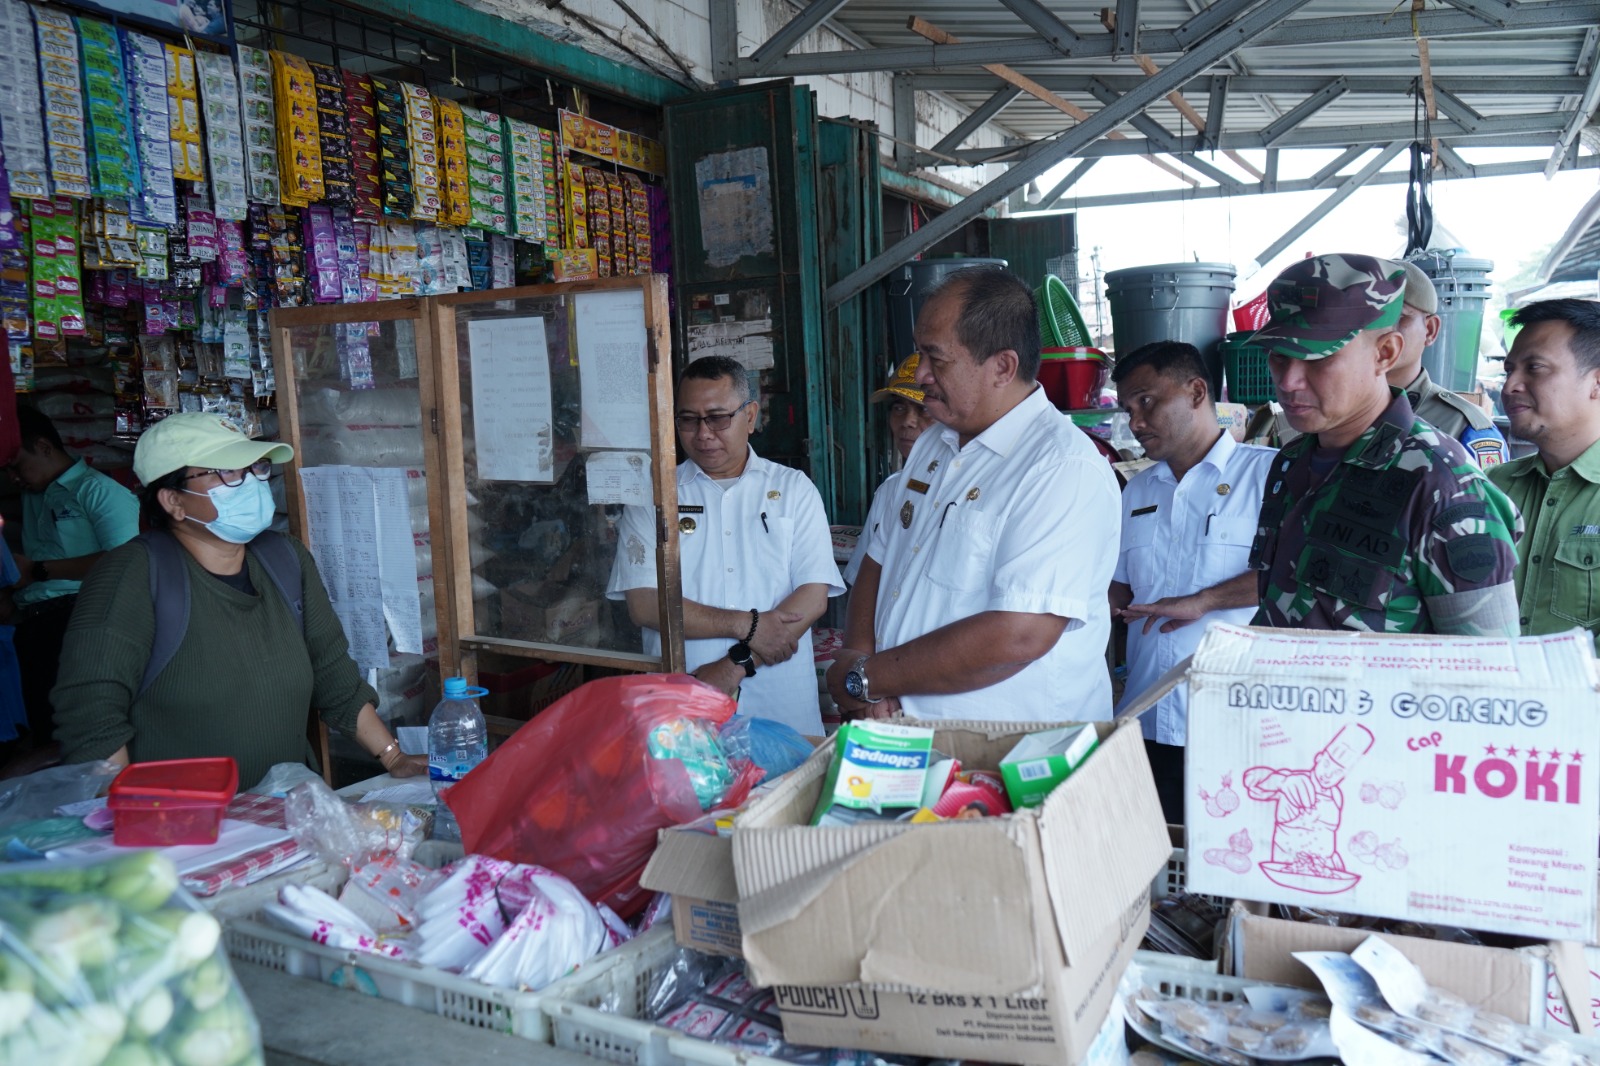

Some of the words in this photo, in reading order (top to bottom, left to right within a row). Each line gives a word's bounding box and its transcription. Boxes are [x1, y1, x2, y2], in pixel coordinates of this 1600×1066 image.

[1323, 520, 1354, 544] TNI
[1356, 534, 1390, 556] AD
[1361, 662, 1430, 670] EMPAT
[1391, 692, 1548, 727] GORENG
[1407, 731, 1442, 751] Cap
[851, 747, 922, 768] Salonpas
[1434, 753, 1581, 804] KOKI
[410, 807, 432, 823] 5000
[1508, 856, 1549, 869] Bawang
[1508, 868, 1547, 881] Tepung
[1507, 880, 1544, 893] Minyak
[1548, 886, 1583, 897] makan
[776, 985, 838, 1009] POUCH
[932, 993, 966, 1006] Bks
[1005, 997, 1048, 1011] Liter
